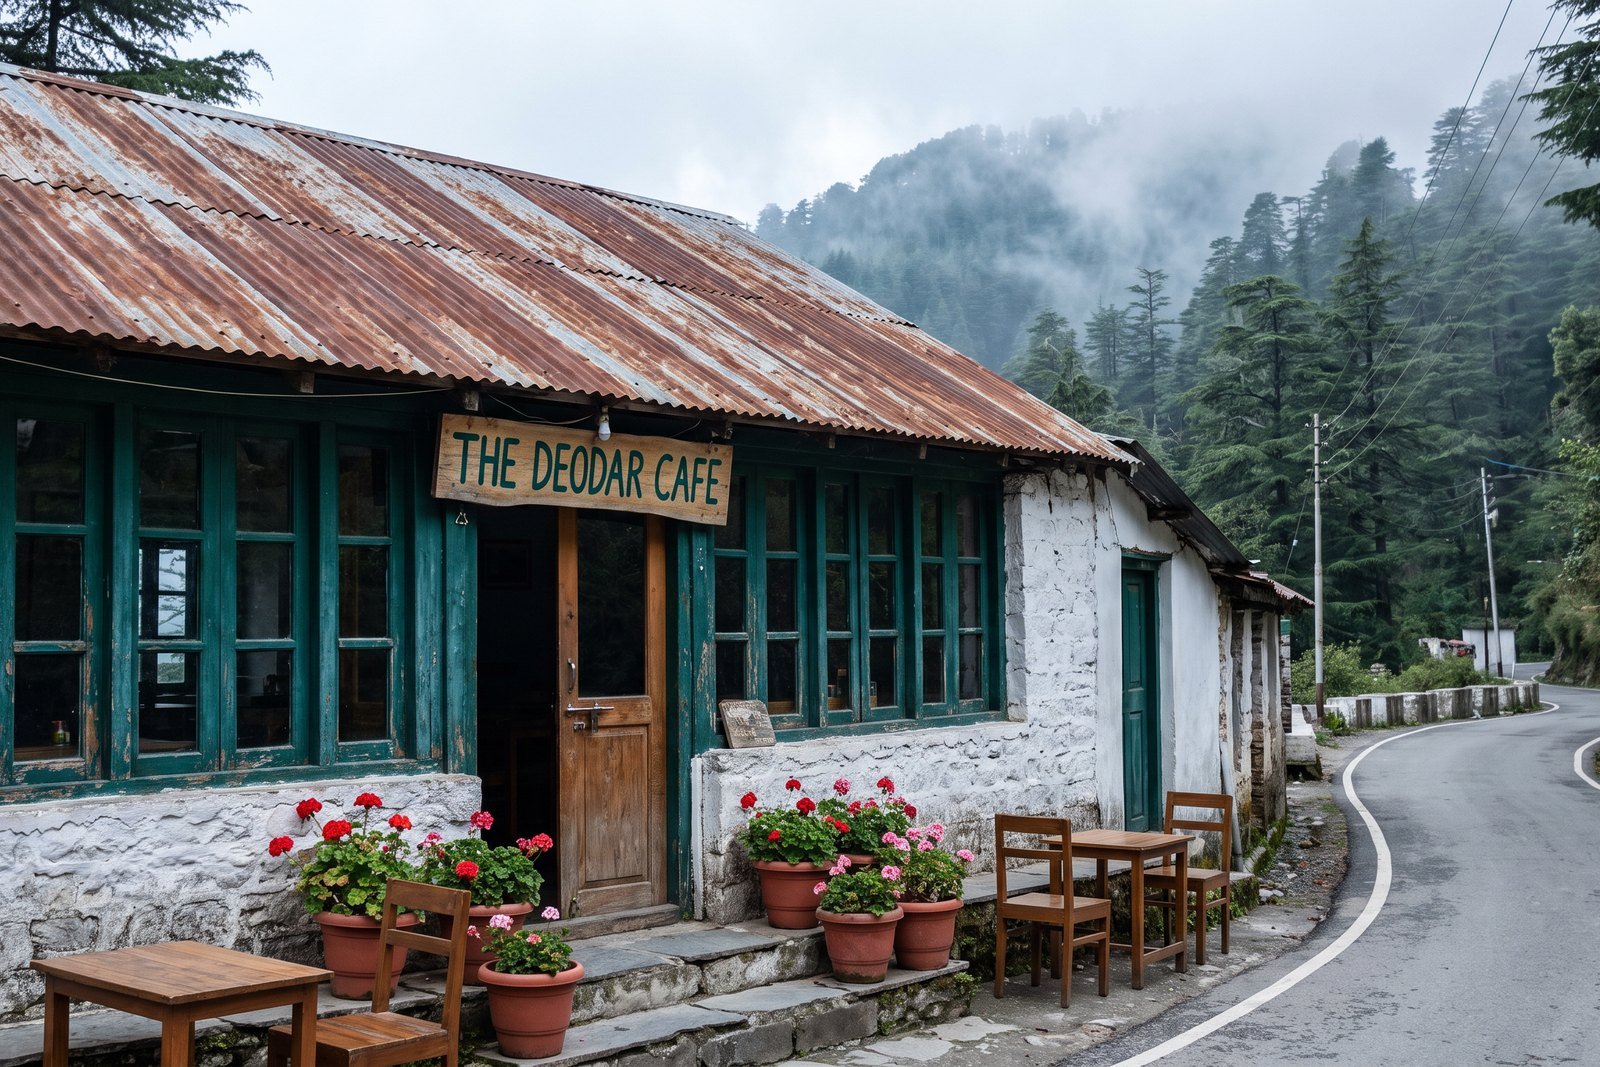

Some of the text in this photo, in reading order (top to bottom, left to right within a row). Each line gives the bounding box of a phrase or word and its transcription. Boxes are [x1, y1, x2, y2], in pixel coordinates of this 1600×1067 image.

[453, 432, 722, 505] THE DEODAR CAFE
